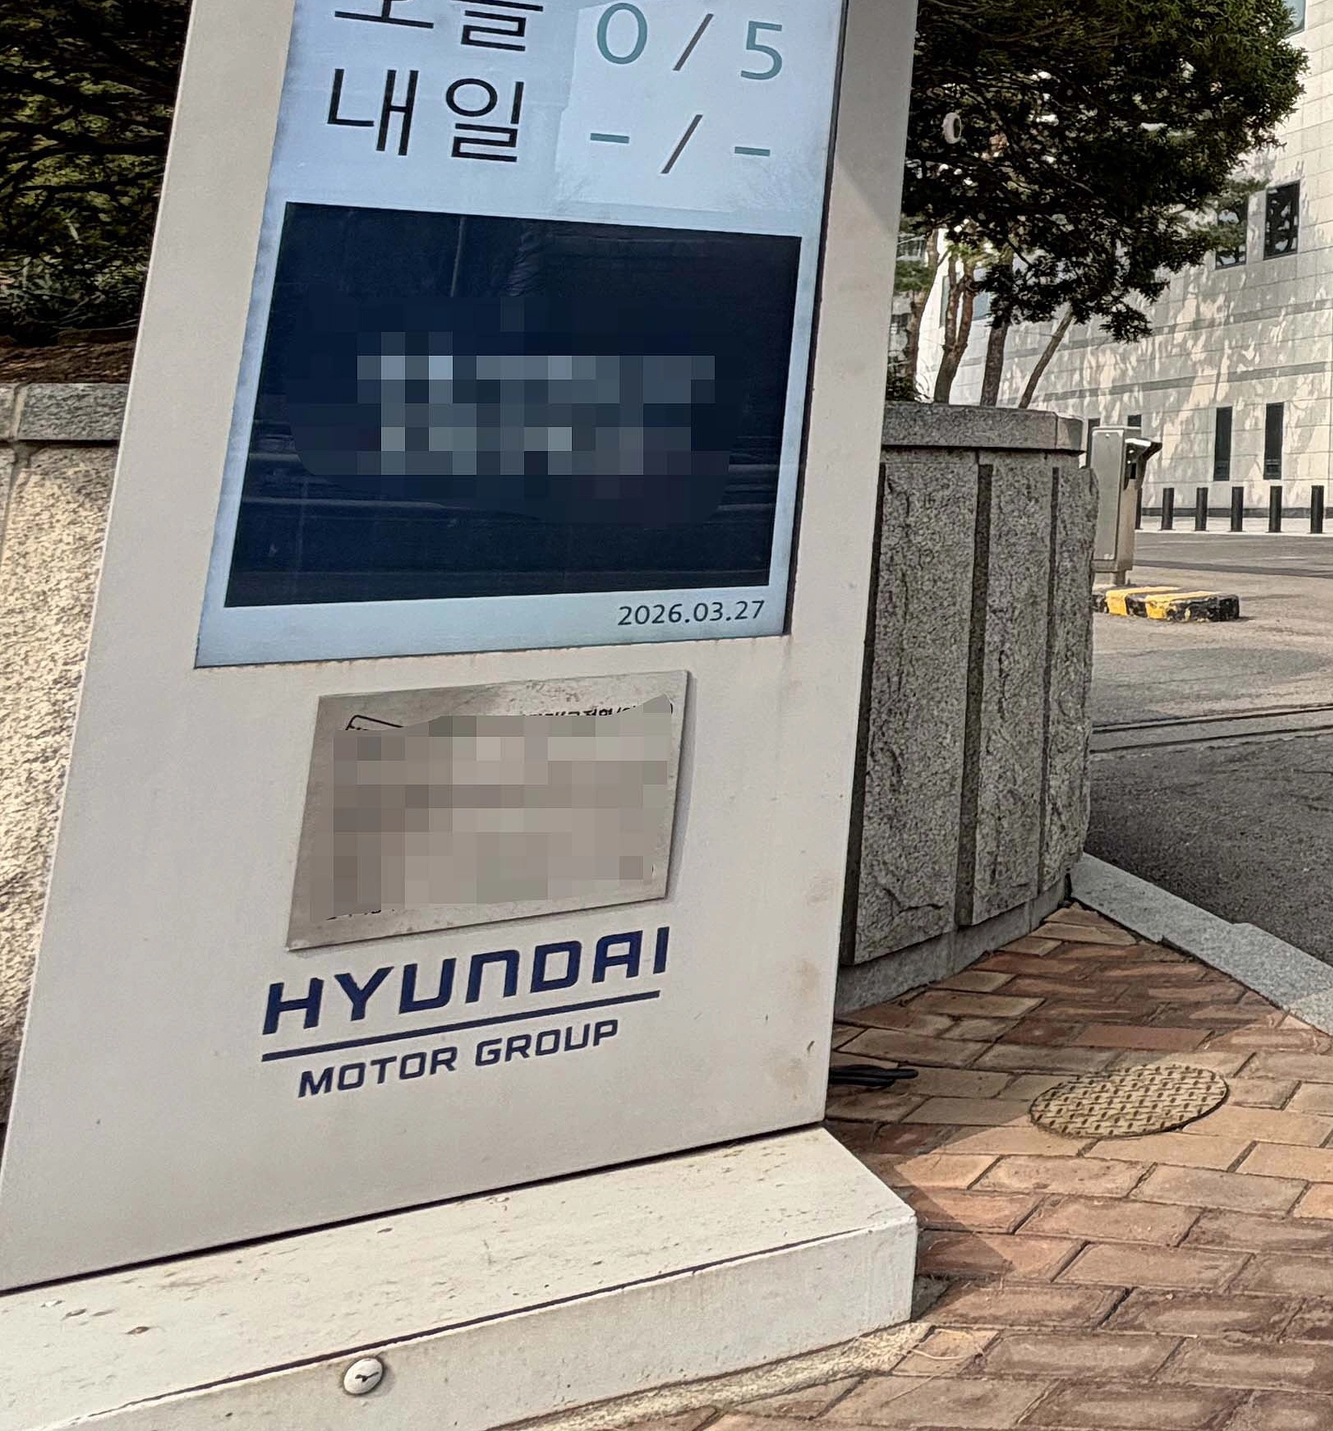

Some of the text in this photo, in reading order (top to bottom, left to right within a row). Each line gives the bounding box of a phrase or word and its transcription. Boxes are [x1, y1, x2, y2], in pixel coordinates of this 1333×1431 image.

[327, 68, 525, 164] 내일
[617, 600, 766, 626] 2026.03.27
[262, 926, 670, 1036] HYUNDAI
[298, 1019, 618, 1098] MOTOR GROUP
